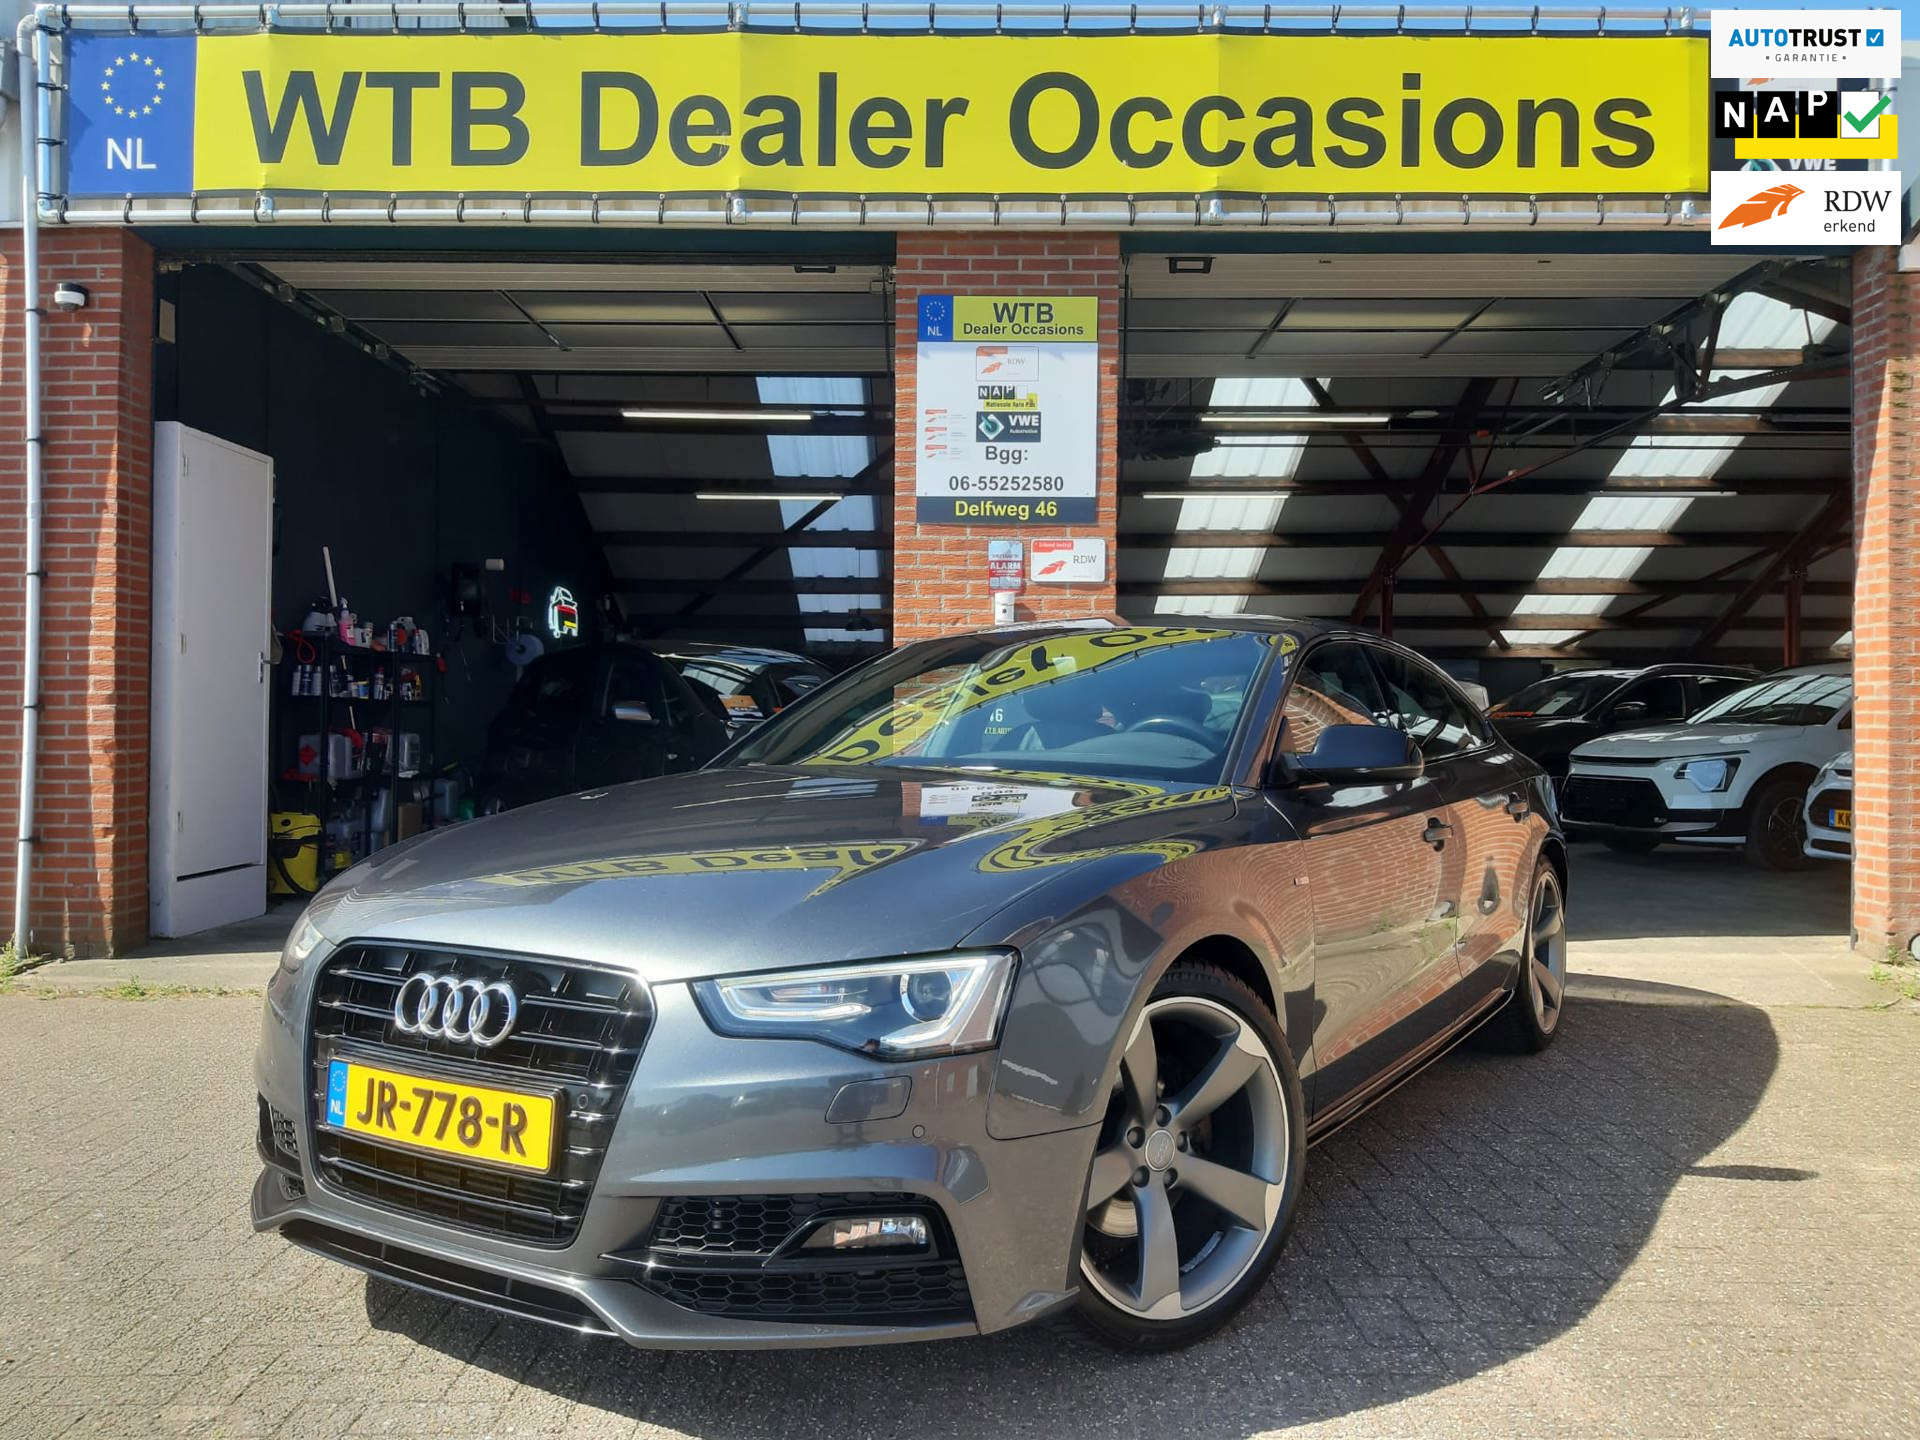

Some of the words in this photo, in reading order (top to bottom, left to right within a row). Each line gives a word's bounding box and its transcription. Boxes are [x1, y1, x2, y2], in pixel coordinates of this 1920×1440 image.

[242, 69, 530, 167] WTB
[580, 71, 970, 168] Dealer
[1009, 71, 1655, 169] Occasions
[107, 138, 156, 170] NL
[993, 302, 1054, 324] WTB
[927, 325, 943, 337] NL
[963, 323, 1007, 335] Dealer
[1011, 323, 1084, 335] Occasions
[979, 385, 1013, 397] NAP
[1008, 414, 1040, 427] VWE
[985, 446, 1028, 465] Bgg:
[949, 475, 1064, 492] 06-55252580
[955, 501, 1029, 519] Delfweg
[1035, 501, 1057, 517] 46
[990, 561, 1021, 570] ALARM
[1072, 555, 1097, 564] RDW
[330, 1100, 344, 1115] NL
[357, 1077, 528, 1158] JR-778-R
